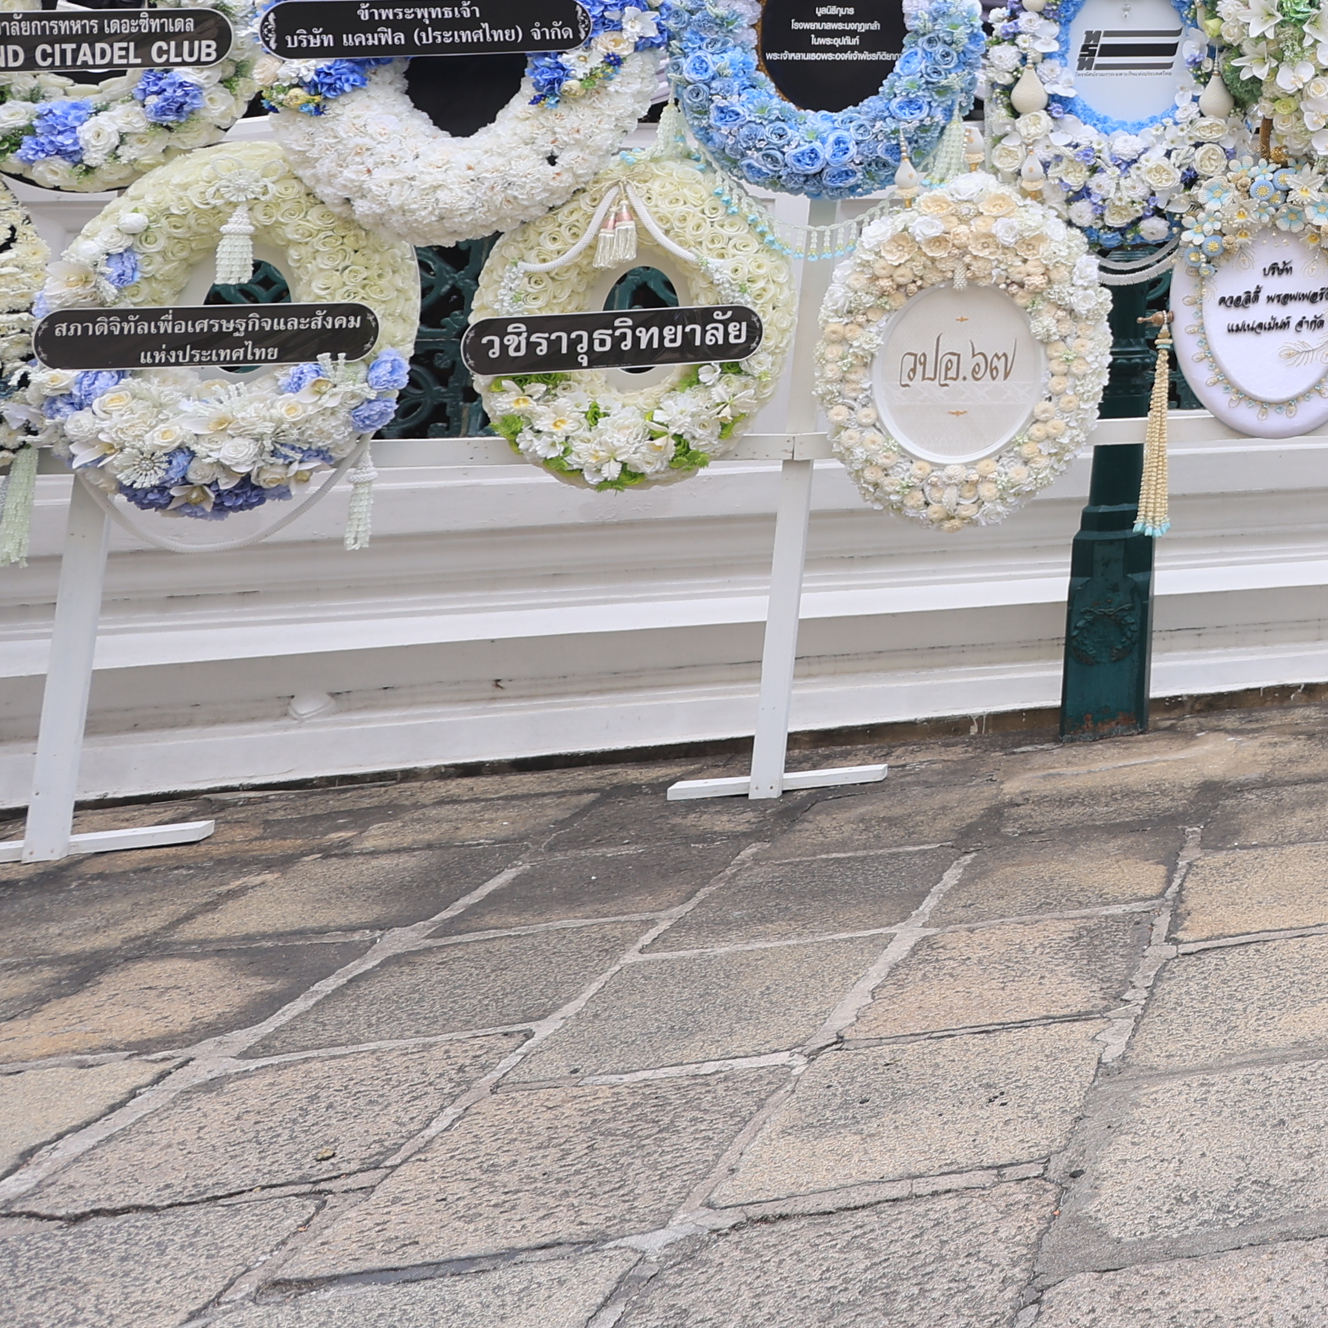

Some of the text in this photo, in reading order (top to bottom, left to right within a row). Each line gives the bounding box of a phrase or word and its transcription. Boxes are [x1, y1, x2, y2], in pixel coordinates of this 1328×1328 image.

[357, 0, 481, 24] ข้าพระพุทธเจ้า
[0, 13, 98, 36] าลัยการทหาร
[285, 22, 574, 48] บริษัท แคมฟิล (ประเทศไทย) จำกัด
[791, 19, 880, 32] โรงพยาบาลพระมงกุฎเกล้า
[35, 41, 142, 67] CITADEL
[151, 40, 218, 63] CLUB
[53, 309, 361, 337] สภาดิจิทัลเพื่อเศรษฐกิจและสังคม
[1294, 313, 1325, 333] จำกัด
[481, 310, 748, 367] วชิราวุธวิทยาลัย
[139, 340, 279, 364] แห่งประเทศไทย
